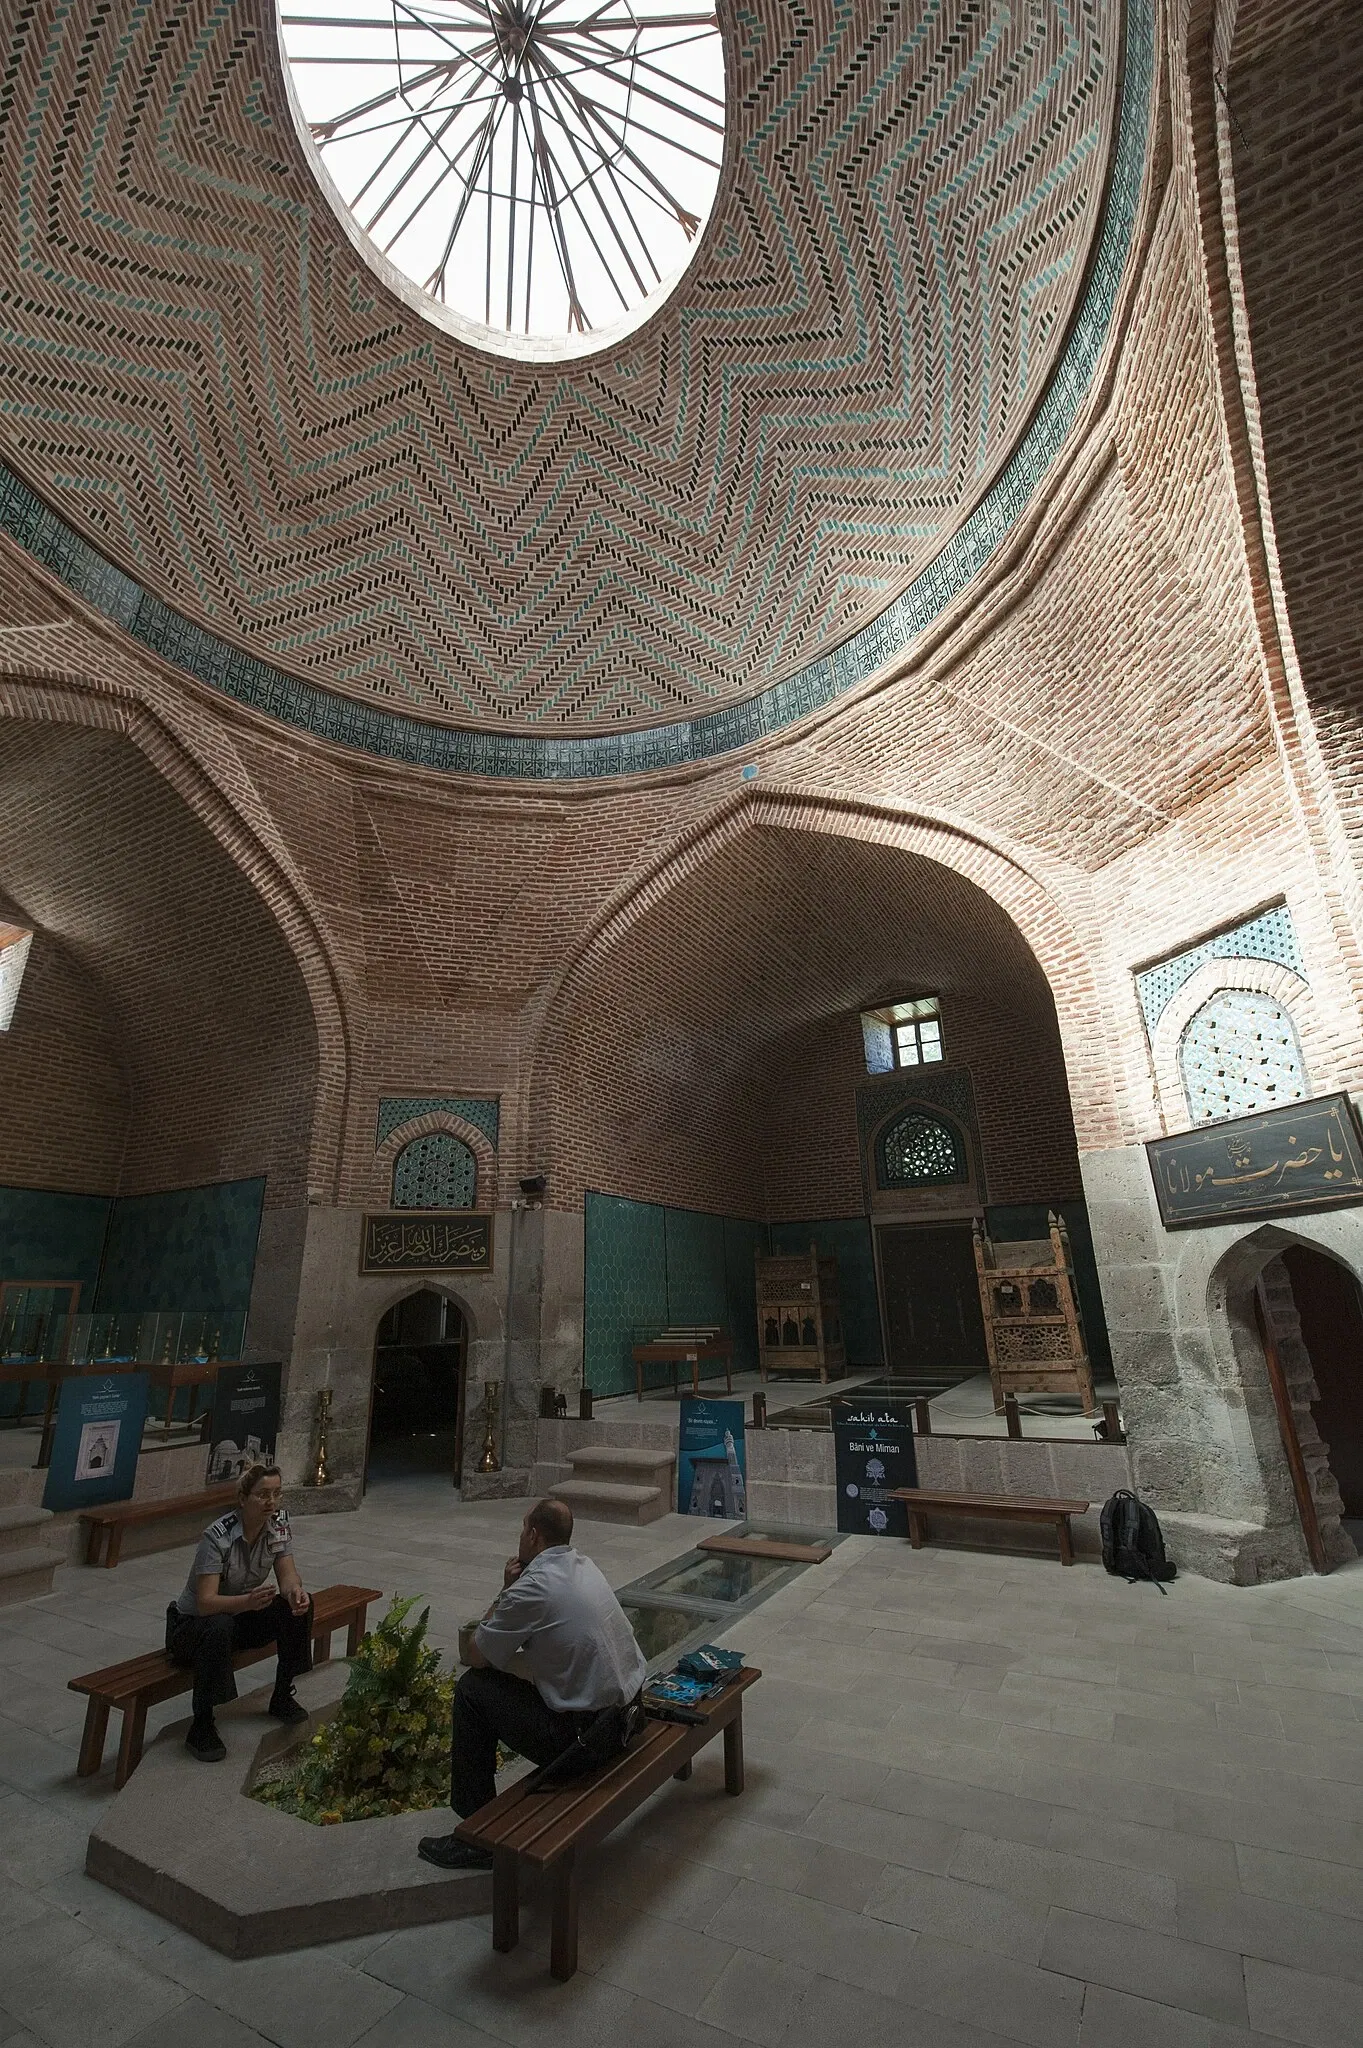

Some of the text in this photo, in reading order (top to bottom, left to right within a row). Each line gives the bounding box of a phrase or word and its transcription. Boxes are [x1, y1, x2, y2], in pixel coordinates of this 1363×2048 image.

[1166, 1158, 1214, 1194] مولانا
[1211, 1135, 1323, 1187] حضرت
[1323, 1128, 1343, 1180] يا
[847, 1412, 898, 1423] sahib ata
